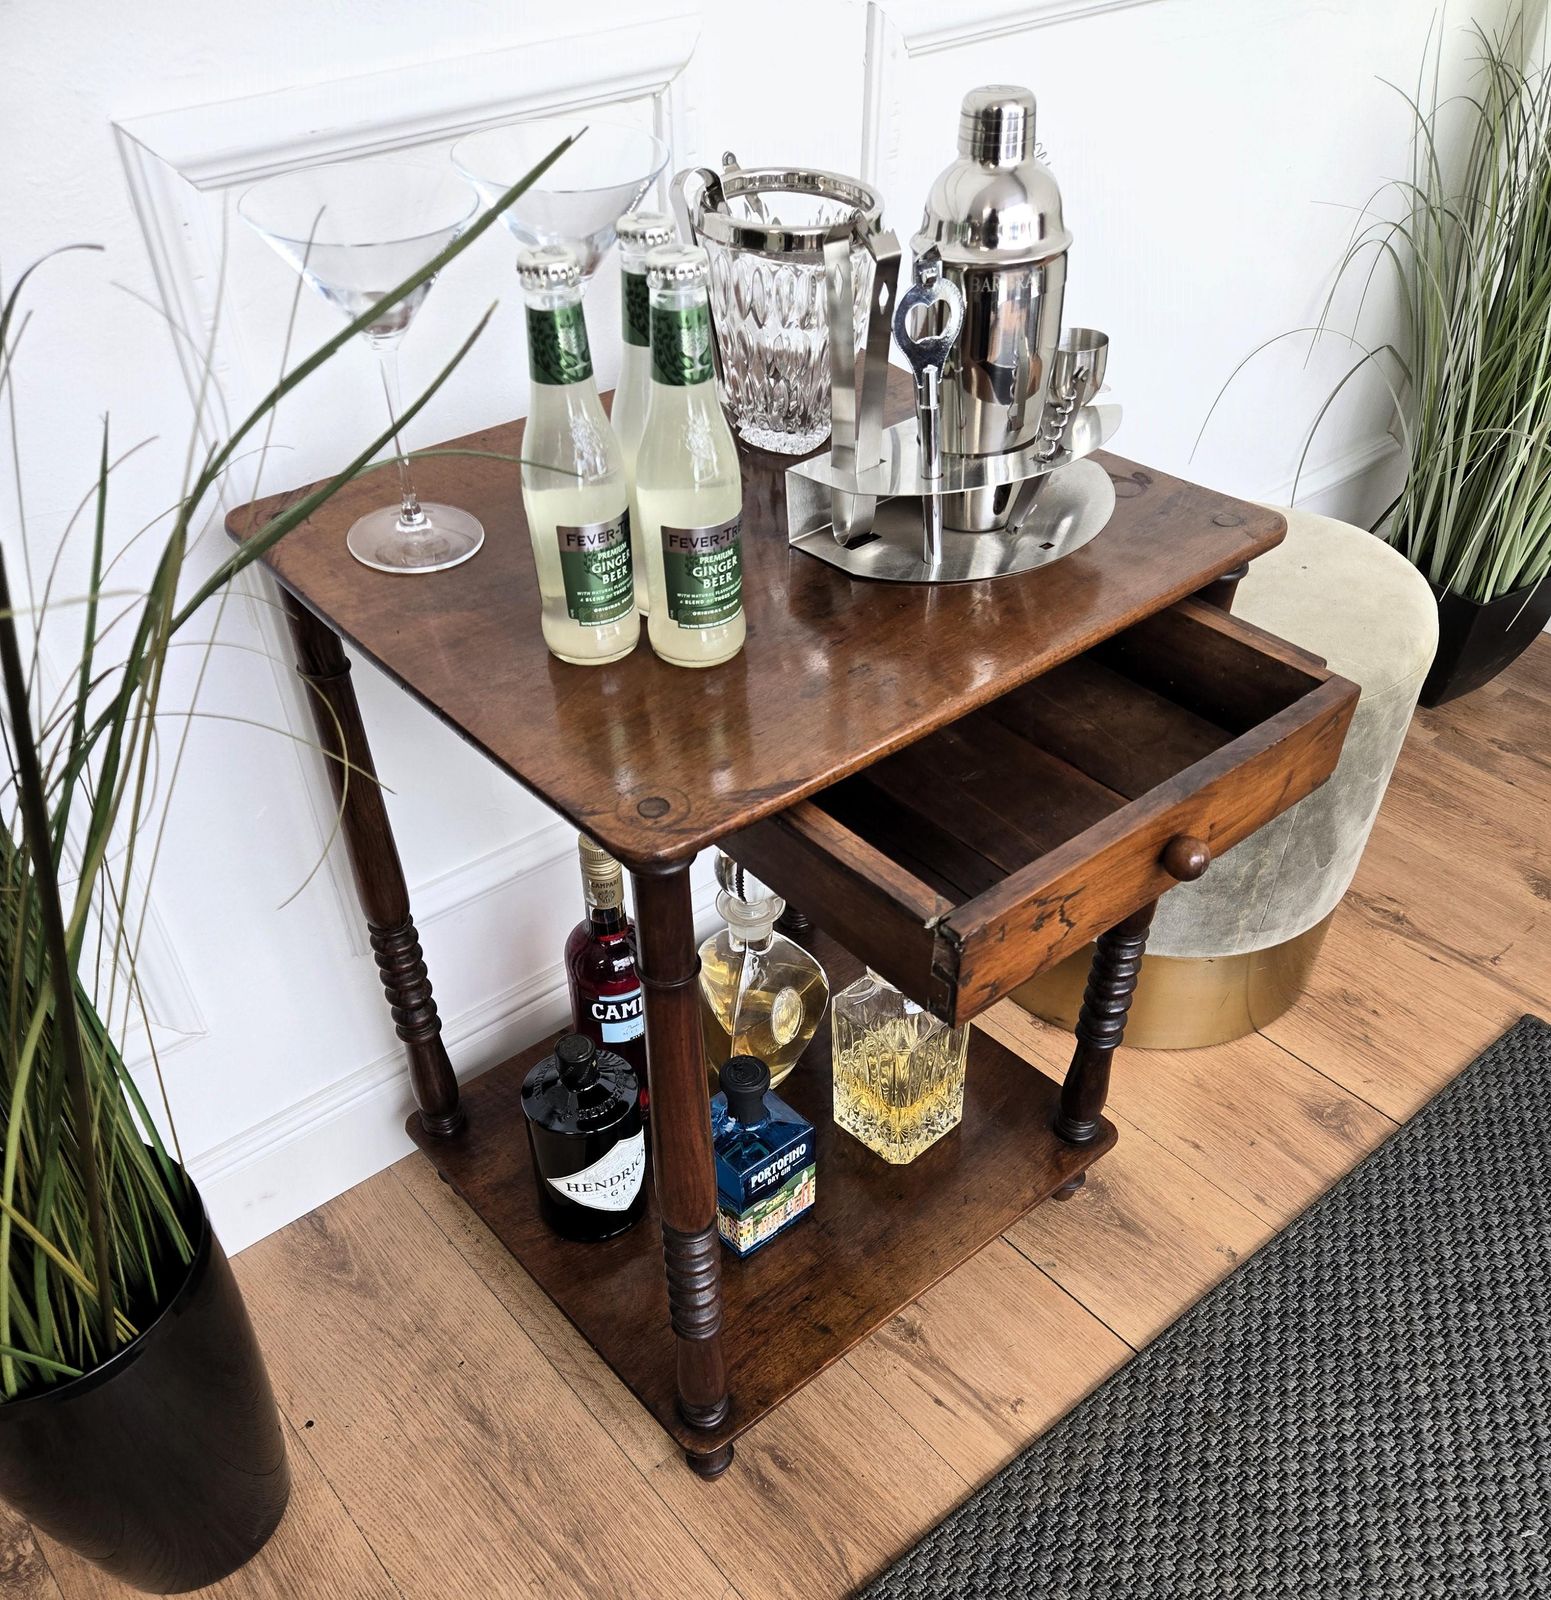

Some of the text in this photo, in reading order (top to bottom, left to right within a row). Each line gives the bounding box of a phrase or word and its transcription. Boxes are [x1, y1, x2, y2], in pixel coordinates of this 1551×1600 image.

[591, 549, 630, 574] GINGER
[597, 541, 627, 561] PREMIUM
[699, 547, 734, 565] PREMIUM
[602, 565, 628, 585] BEER
[692, 555, 738, 577] GINGER
[703, 572, 733, 589] BEER
[750, 1143, 807, 1188] PORTOFINO
[767, 1164, 792, 1186] DRY GIN
[611, 1175, 636, 1197] GIN
